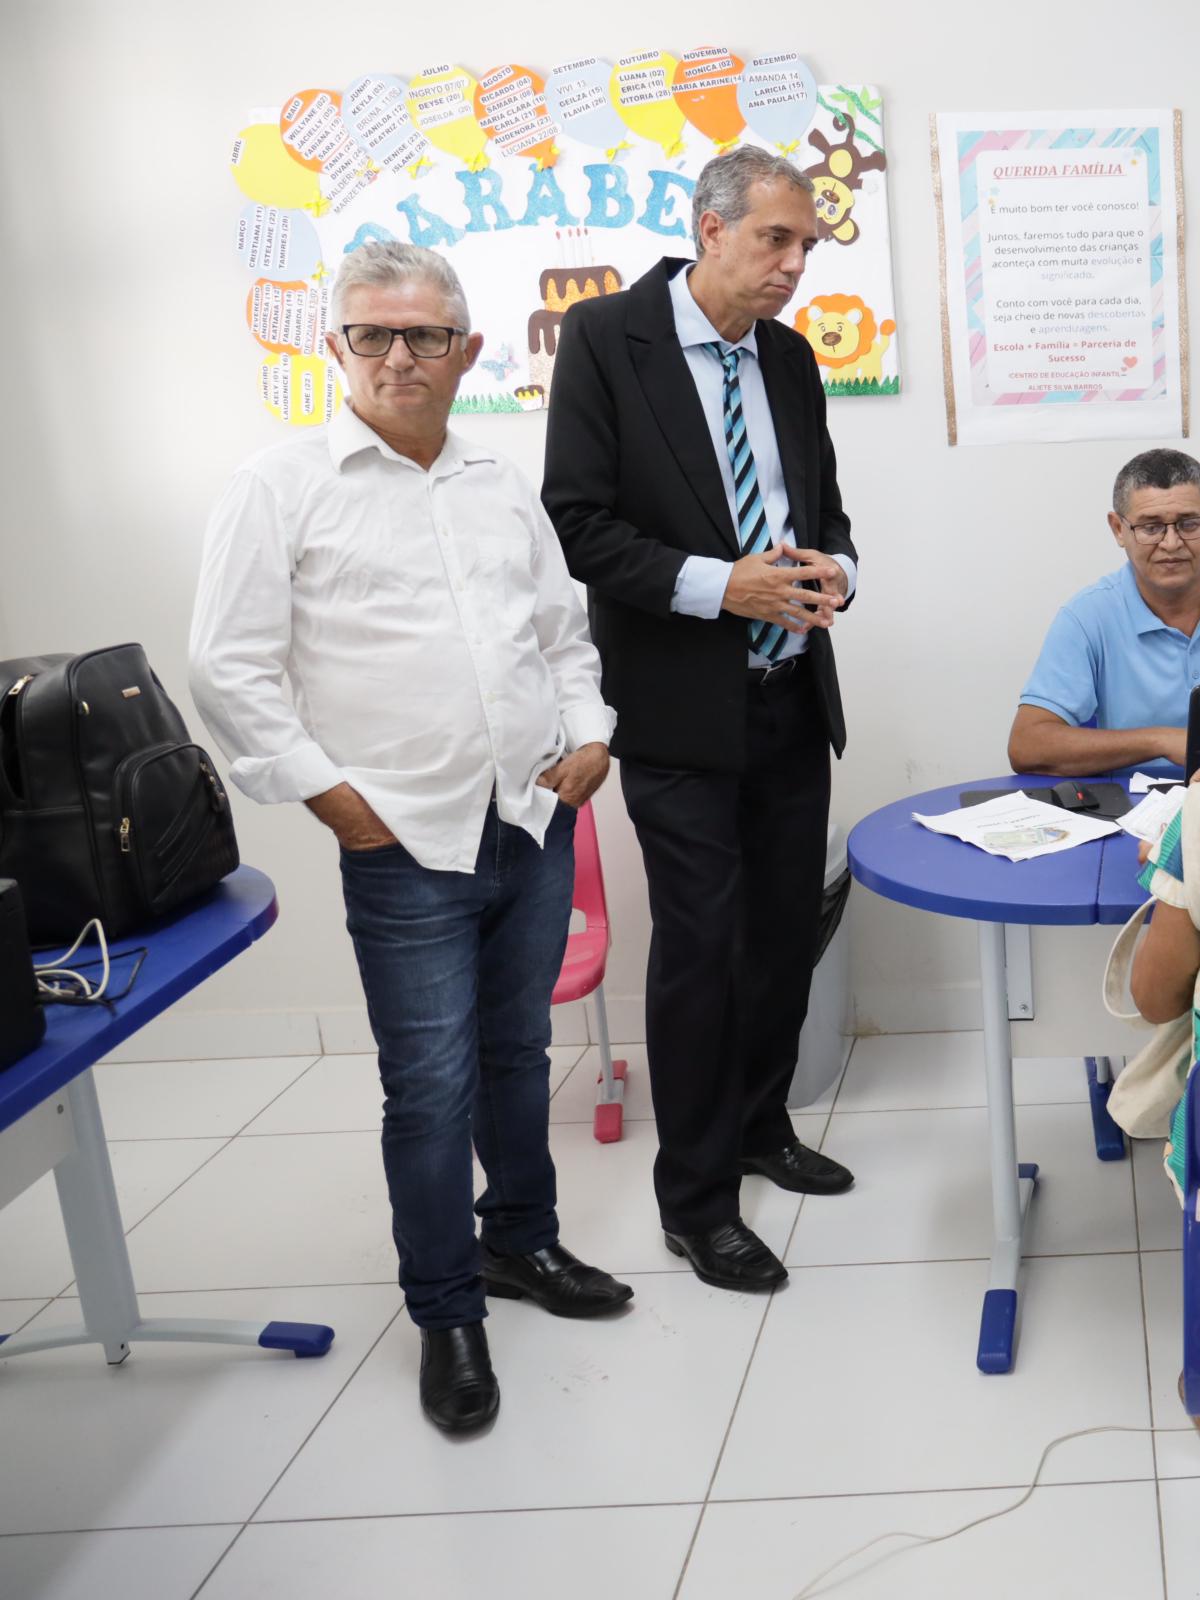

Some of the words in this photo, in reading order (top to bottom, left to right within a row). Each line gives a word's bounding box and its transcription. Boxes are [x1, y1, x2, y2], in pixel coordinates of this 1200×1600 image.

[620, 51, 659, 65] OUTUBRO
[683, 48, 727, 60] NOVEMBRO
[753, 53, 797, 66] DEZEMBRO
[422, 65, 449, 76] JULHO
[553, 58, 596, 74] SETEMBRO
[686, 64, 717, 77] MONICA
[483, 67, 511, 88] AGOSTO
[620, 73, 647, 81] LUANA
[621, 83, 646, 93] ERICA
[672, 83, 698, 92] MARIA
[749, 100, 765, 108] ANA
[993, 166, 1057, 178] QUERIDA
[1062, 161, 1123, 175] FAMÍLIA
[1000, 204, 1027, 213] muito
[1031, 202, 1052, 212] bom
[1056, 202, 1068, 212] ter
[1072, 202, 1094, 211] você
[1097, 202, 1139, 210] conosco!
[1024, 232, 1064, 240] faremos
[1067, 231, 1089, 239] tudo
[1092, 231, 1113, 240] para
[1117, 231, 1134, 240] que
[995, 246, 1077, 255] desenvolvimento
[1080, 244, 1096, 253] das
[1100, 243, 1139, 252] crianças
[992, 259, 1035, 268] aconteça
[1061, 258, 1088, 266] muita
[996, 300, 1024, 309] Conto
[1051, 298, 1072, 306] você
[1075, 298, 1096, 307] para
[1100, 297, 1121, 305] cada
[993, 315, 1012, 323] seja
[1015, 313, 1040, 321] cheio
[1043, 312, 1055, 320] de
[994, 343, 1024, 351] Escola
[1081, 340, 1121, 348] Parceria
[1125, 339, 1136, 348] de
[1048, 354, 1086, 362] Sucesso
